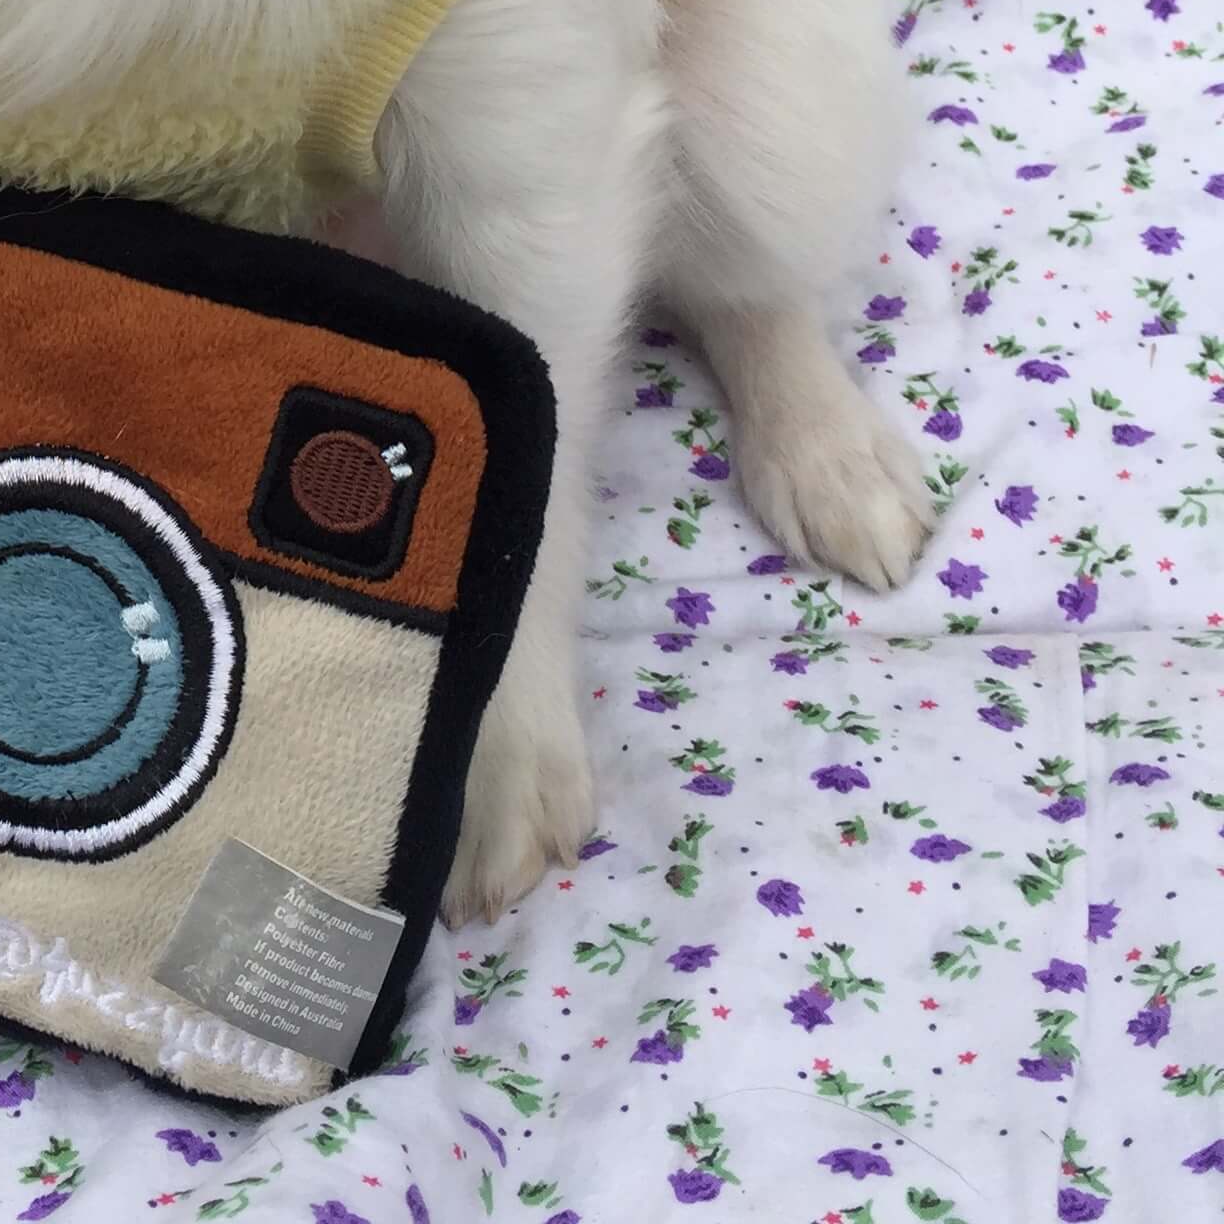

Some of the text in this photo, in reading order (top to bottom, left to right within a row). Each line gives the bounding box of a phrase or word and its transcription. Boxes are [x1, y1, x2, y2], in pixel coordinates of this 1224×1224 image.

[263, 922, 318, 960] Polyester
[244, 959, 290, 990] remove
[253, 939, 267, 954] If
[264, 949, 312, 978] product
[310, 968, 353, 994] becomes
[226, 991, 301, 1036] Made in China
[235, 974, 289, 1010] Designed
[287, 1000, 300, 1015] in
